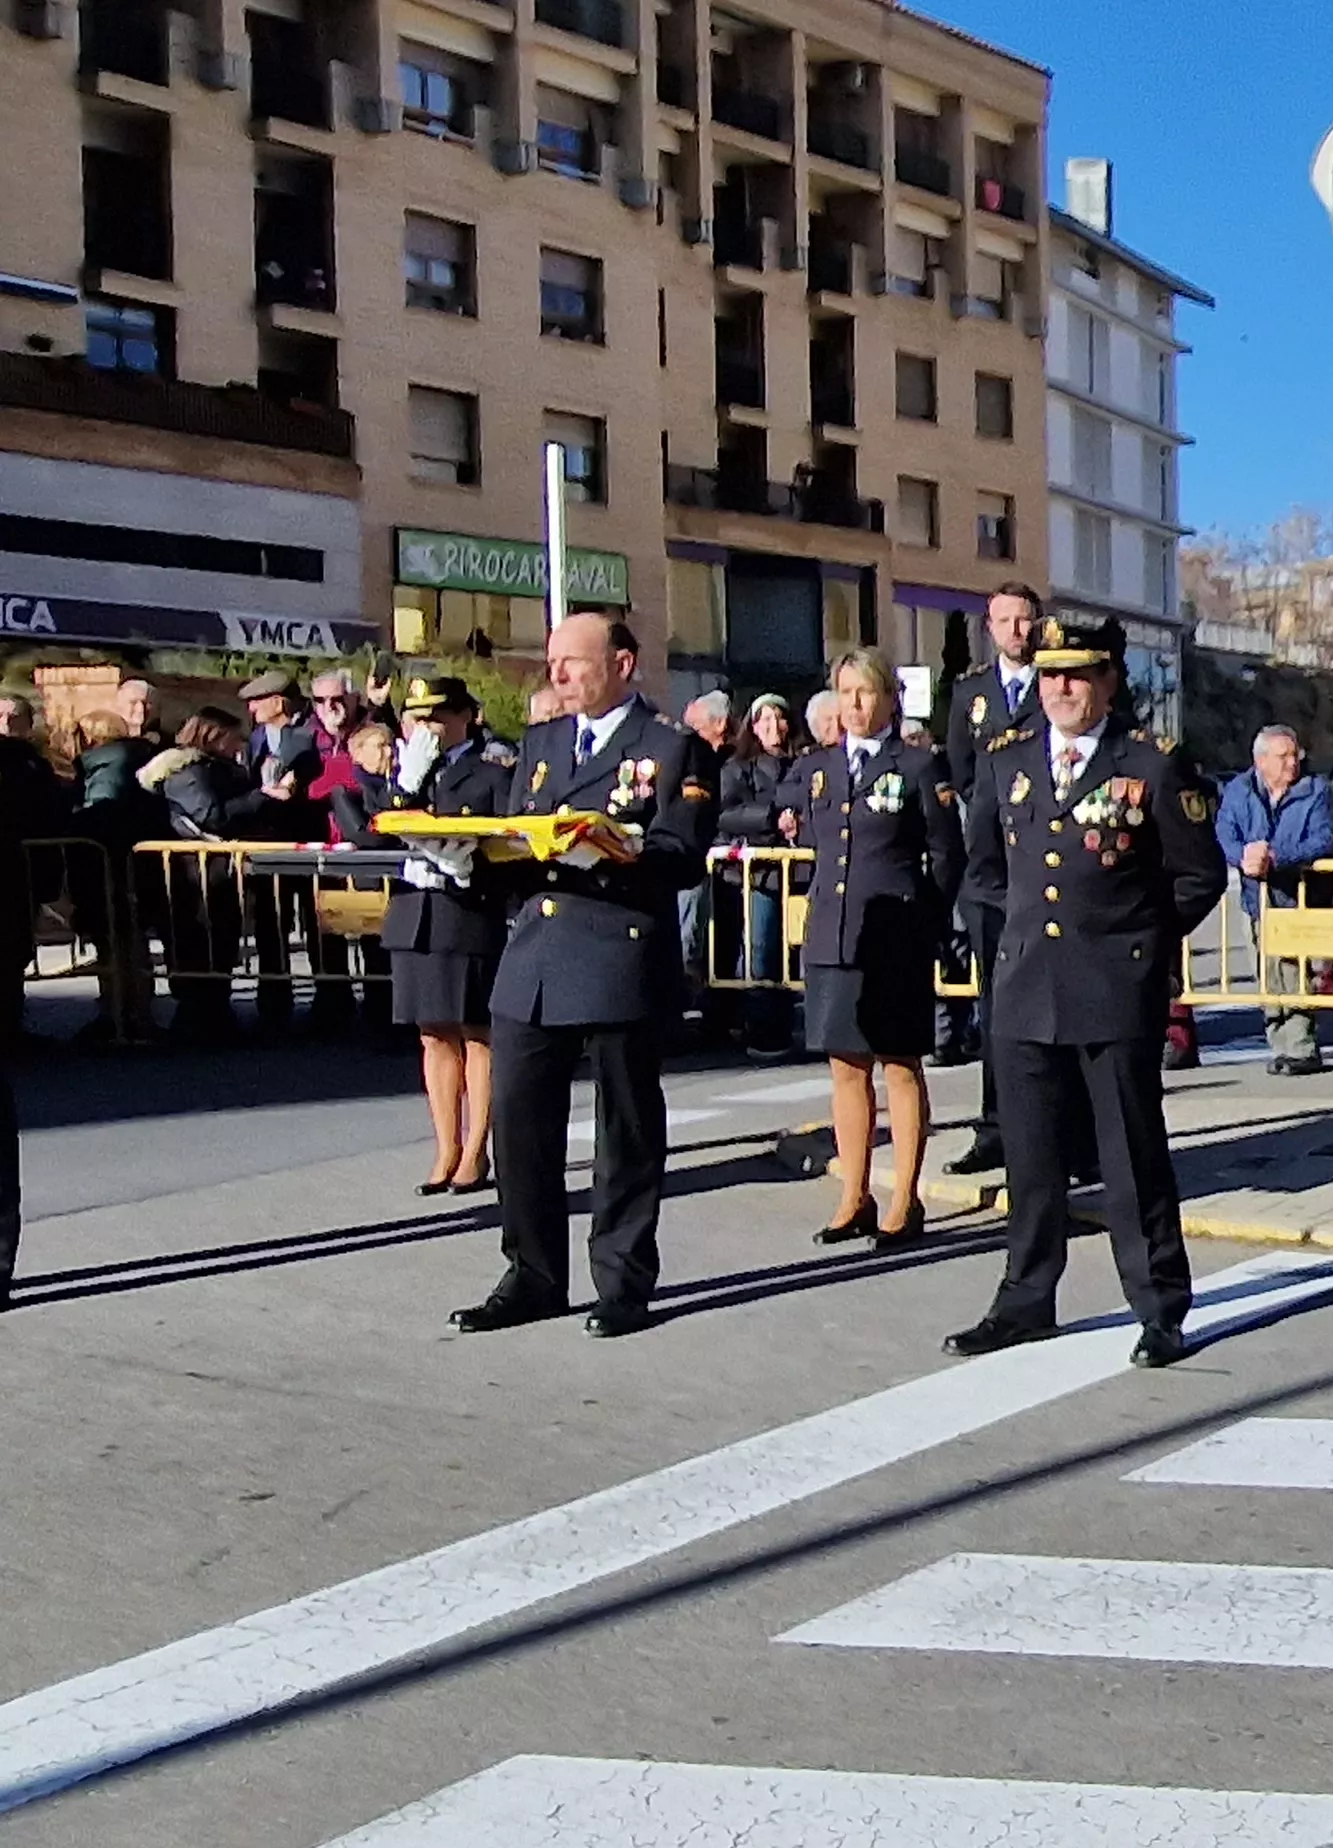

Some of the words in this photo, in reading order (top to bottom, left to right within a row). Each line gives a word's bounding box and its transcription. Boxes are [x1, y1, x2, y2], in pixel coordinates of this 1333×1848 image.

[441, 541, 621, 593] PIROCARAVAL
[0, 598, 57, 632] CA
[238, 619, 326, 650] YMCA
